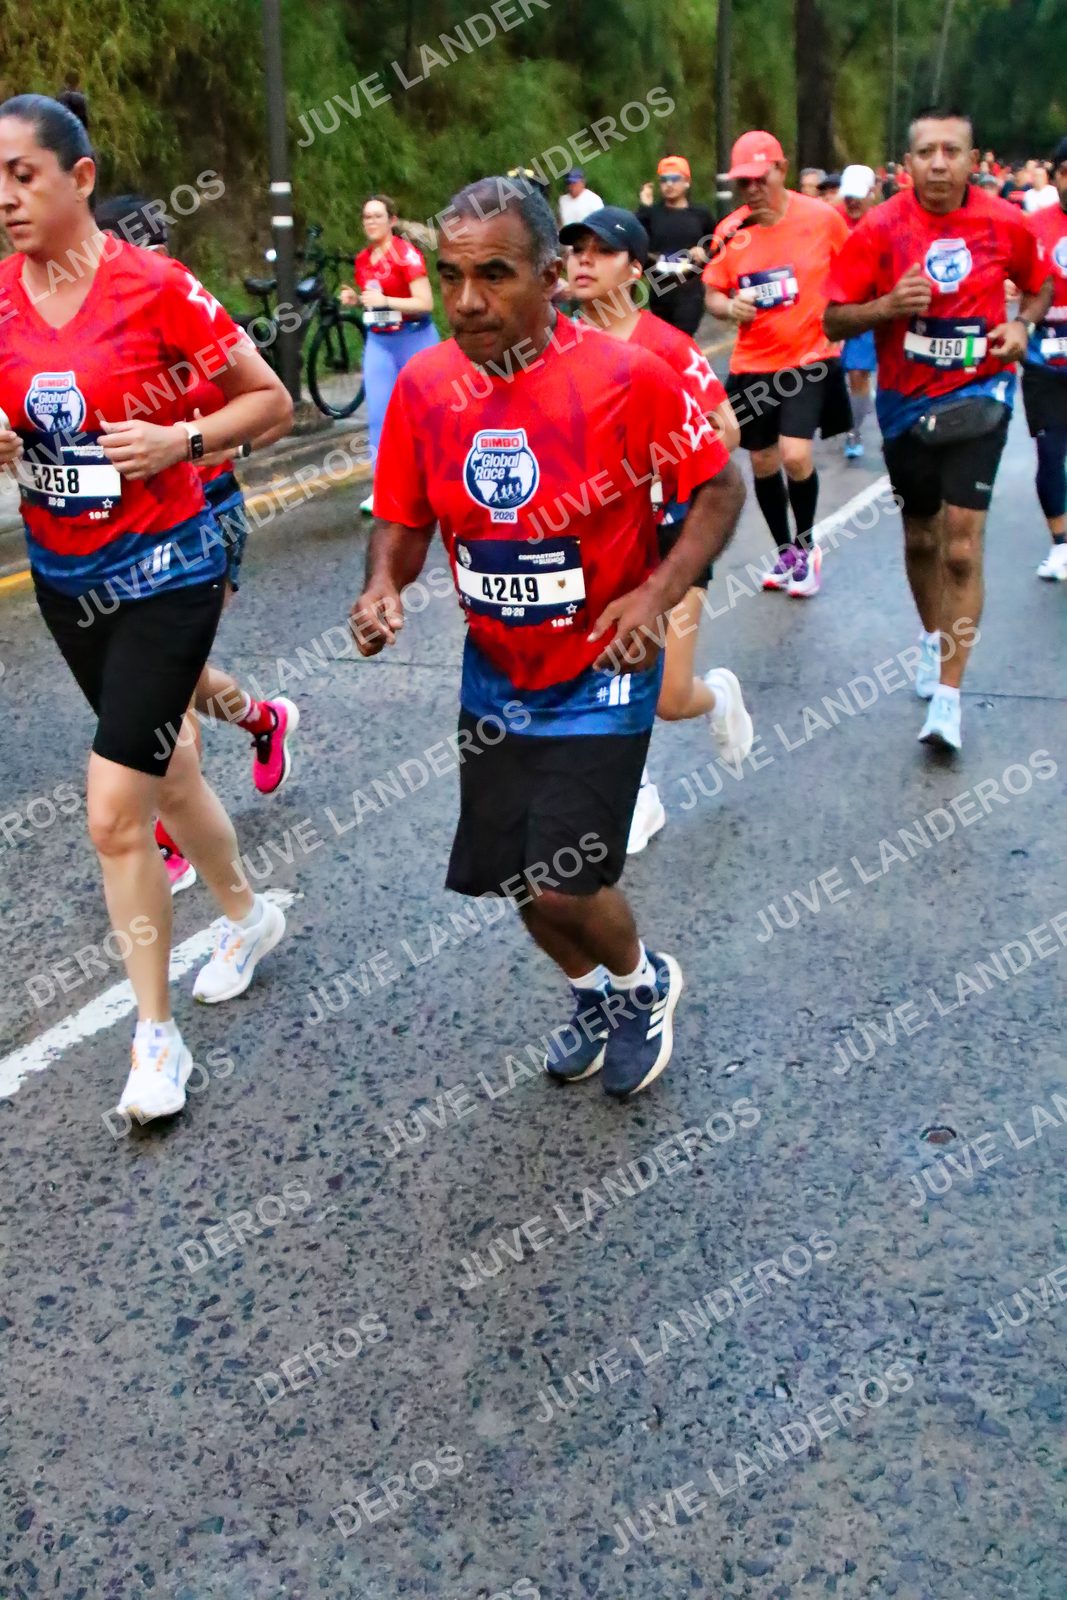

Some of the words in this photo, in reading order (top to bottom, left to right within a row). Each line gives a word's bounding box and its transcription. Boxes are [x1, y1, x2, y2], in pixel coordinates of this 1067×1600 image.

[929, 340, 962, 356] 4150
[37, 379, 70, 388] BIMBO
[37, 391, 70, 404] Global
[33, 403, 59, 415] Race
[480, 437, 520, 449] BIMBO
[481, 453, 520, 468] Global
[32, 464, 80, 494] 5258
[474, 466, 505, 481] Race
[493, 511, 515, 521] 2026
[482, 576, 540, 603] 4249
[550, 616, 574, 628] 10K
